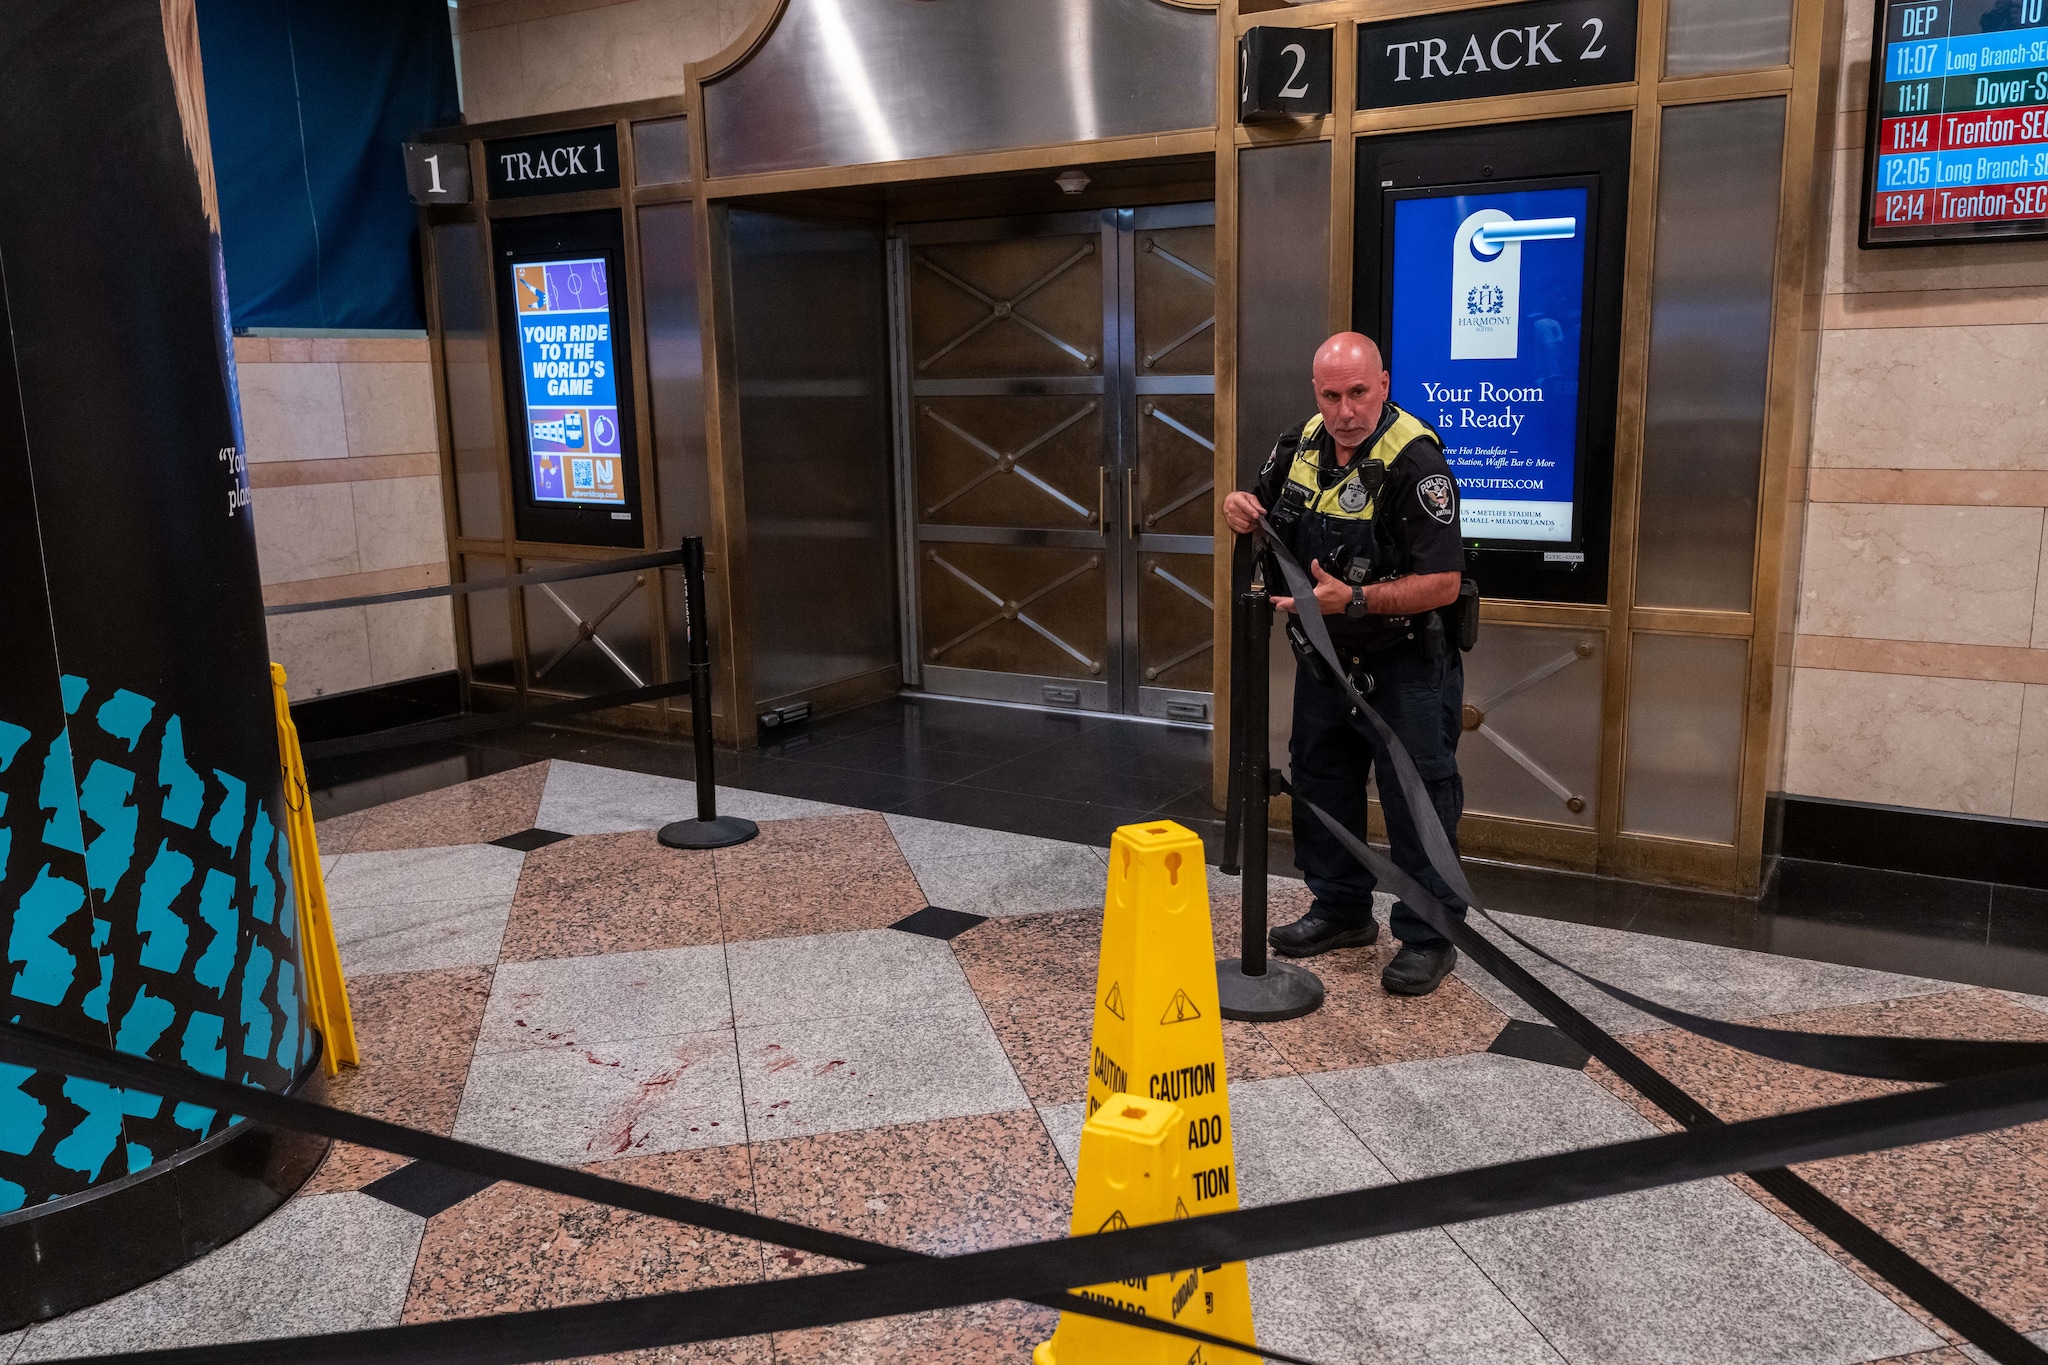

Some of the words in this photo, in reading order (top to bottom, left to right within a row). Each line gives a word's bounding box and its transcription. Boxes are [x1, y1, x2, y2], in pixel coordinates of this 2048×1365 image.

[1902, 6, 1938, 37] DEP
[1386, 23, 1562, 82] TRACK
[1580, 17, 1607, 61] 2
[1897, 44, 1938, 75] 11:07
[1947, 51, 1977, 71] Long
[1981, 41, 2048, 68] Branch-SE
[1277, 43, 1310, 99] 2
[1899, 83, 1929, 112] 11:11
[1975, 71, 2048, 106] Dover-S
[1893, 120, 1928, 149] 11:14
[424, 154, 447, 193] 1
[501, 145, 587, 181] TRACK
[593, 143, 605, 173] 1
[1886, 157, 1931, 186] 12:05
[1937, 160, 1972, 184] Long
[1885, 194, 1925, 222] 12:14
[524, 325, 567, 343] YOUR
[570, 324, 608, 342] RIDE
[1458, 316, 1511, 327] HARMONY
[540, 343, 561, 360] TO
[563, 343, 594, 360] THE
[533, 360, 605, 378] WORLD'S
[547, 379, 593, 396] GAME
[1422, 382, 1473, 403] Your
[1478, 382, 1544, 402] Room
[1438, 409, 1453, 428] is
[1460, 405, 1525, 436] Ready
[1457, 458, 1483, 467] Station,
[1485, 457, 1509, 469] Waffle
[1511, 459, 1524, 467] Bar
[1525, 459, 1534, 467] &
[1535, 459, 1555, 468] More
[1459, 446, 1473, 455] Hot
[1475, 446, 1507, 458] Breakfast
[572, 490, 618, 499] njtworldcup.com
[1420, 478, 1448, 495] POLICE
[1469, 517, 1489, 525] MALL
[1495, 518, 1555, 527] MEADOWLANDS
[1477, 509, 1508, 517] METLIFE
[1508, 510, 1541, 518] STADIUM
[1094, 1046, 1128, 1093] CAUTION
[1149, 1062, 1215, 1102] CAUTION
[1172, 1267, 1198, 1320] CUIDADO
